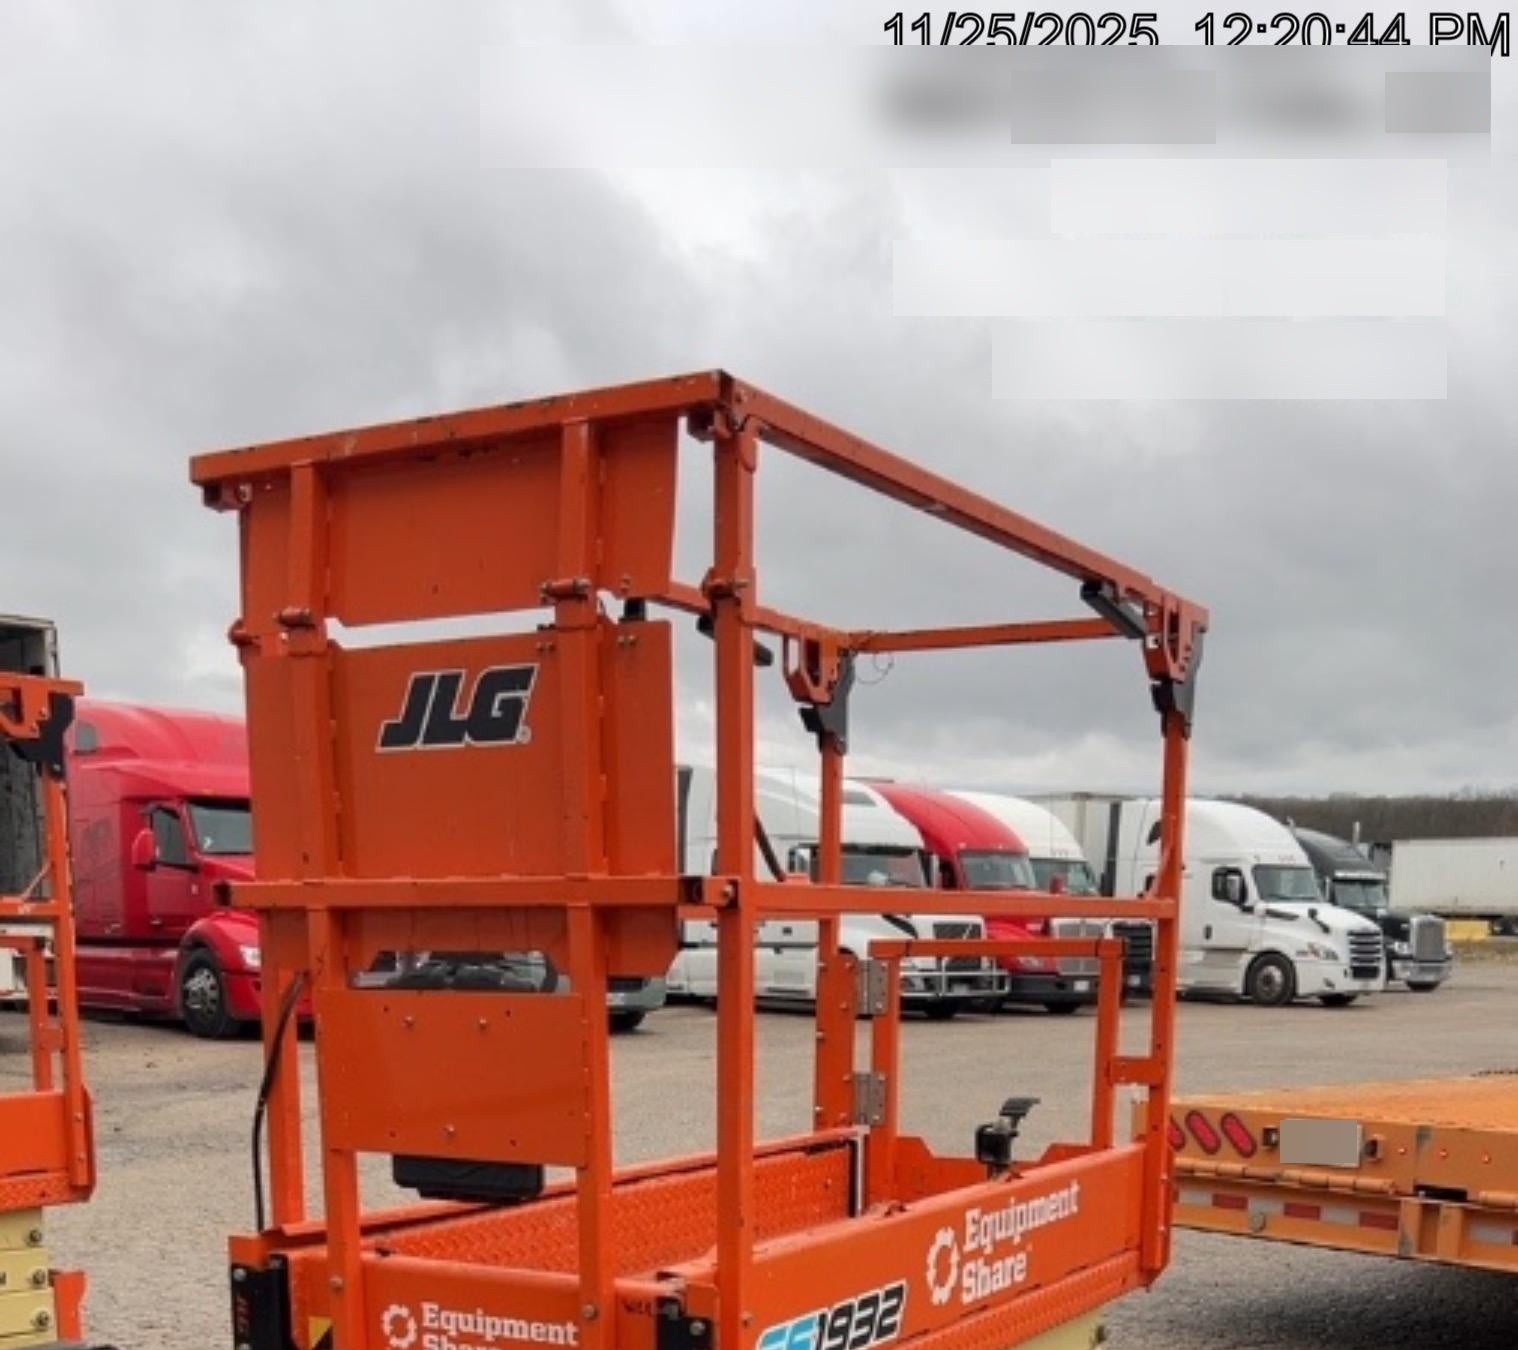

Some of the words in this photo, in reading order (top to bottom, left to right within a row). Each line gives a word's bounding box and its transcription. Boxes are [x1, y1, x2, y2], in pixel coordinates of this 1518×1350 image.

[375, 663, 540, 752] JLG
[965, 1180, 1079, 1254] Equipment
[962, 1252, 1027, 1304] Share
[421, 1301, 578, 1346] Equipment
